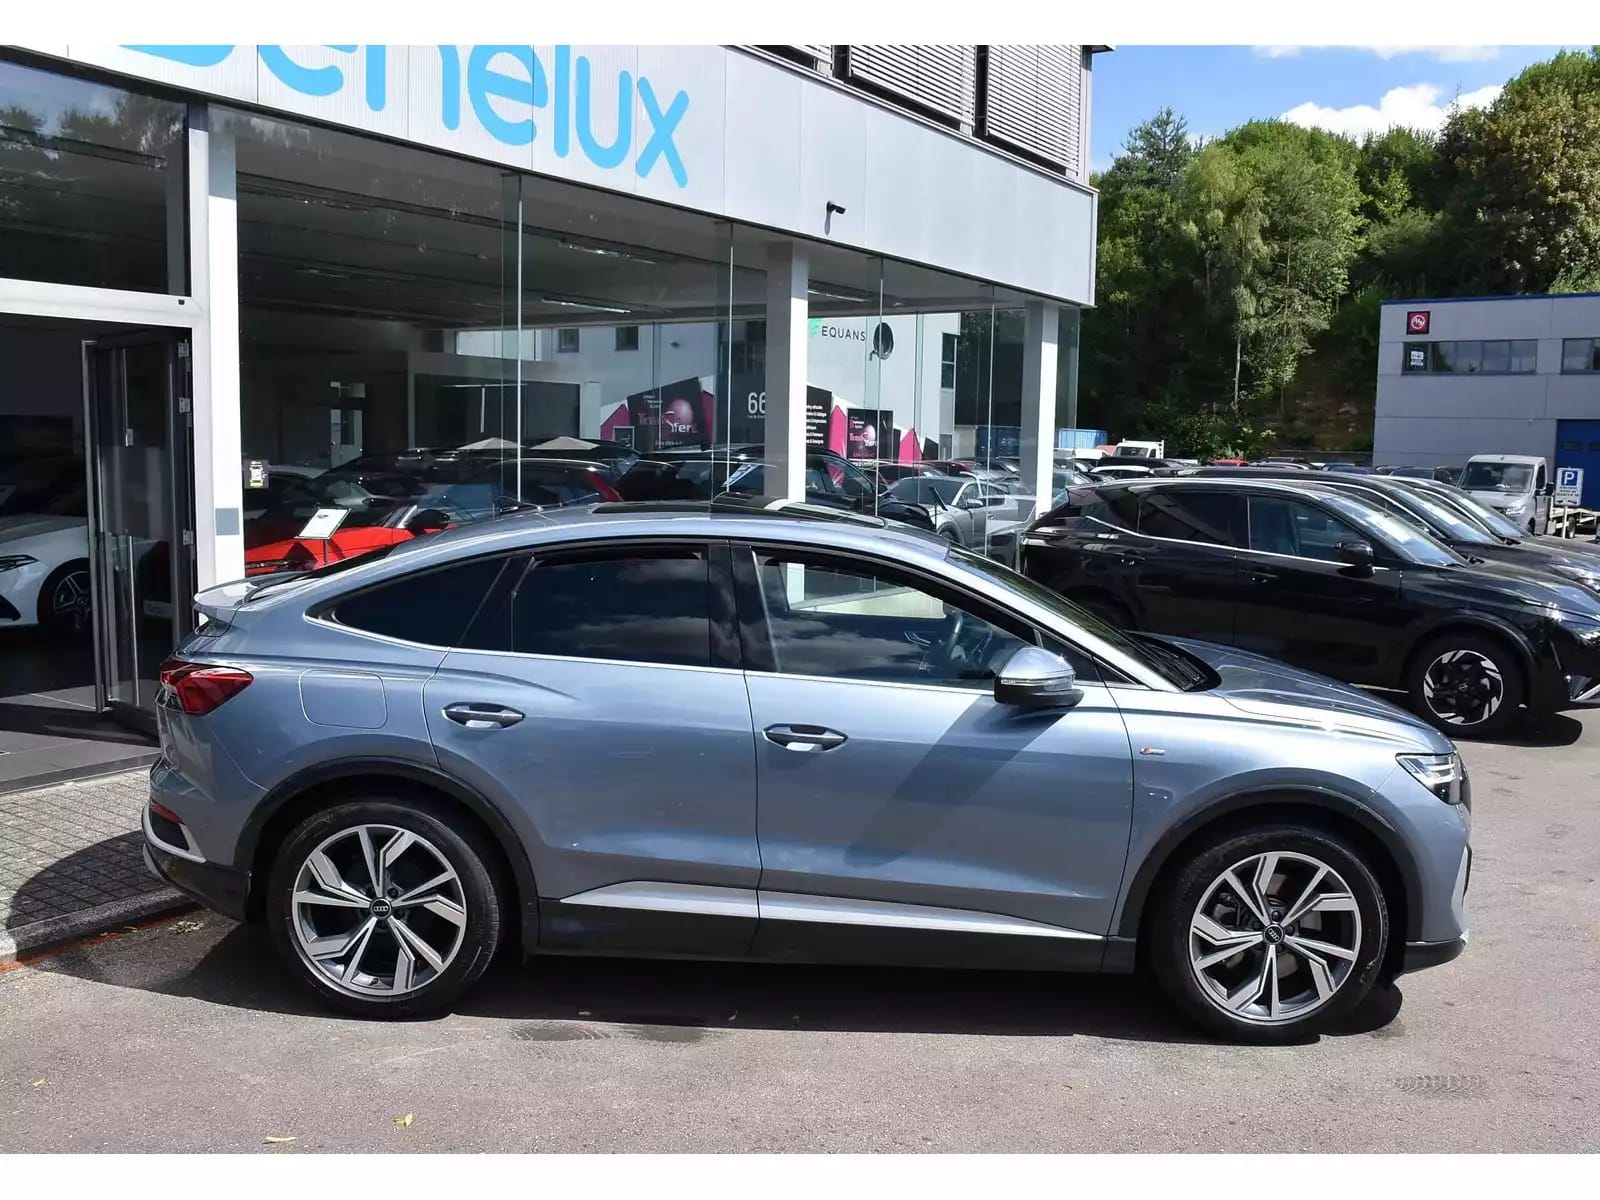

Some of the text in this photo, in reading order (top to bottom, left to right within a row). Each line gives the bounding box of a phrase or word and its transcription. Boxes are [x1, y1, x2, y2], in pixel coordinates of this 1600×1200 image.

[117, 45, 690, 188] nelux
[821, 325, 866, 341] EQUANS
[1563, 471, 1575, 485] P
